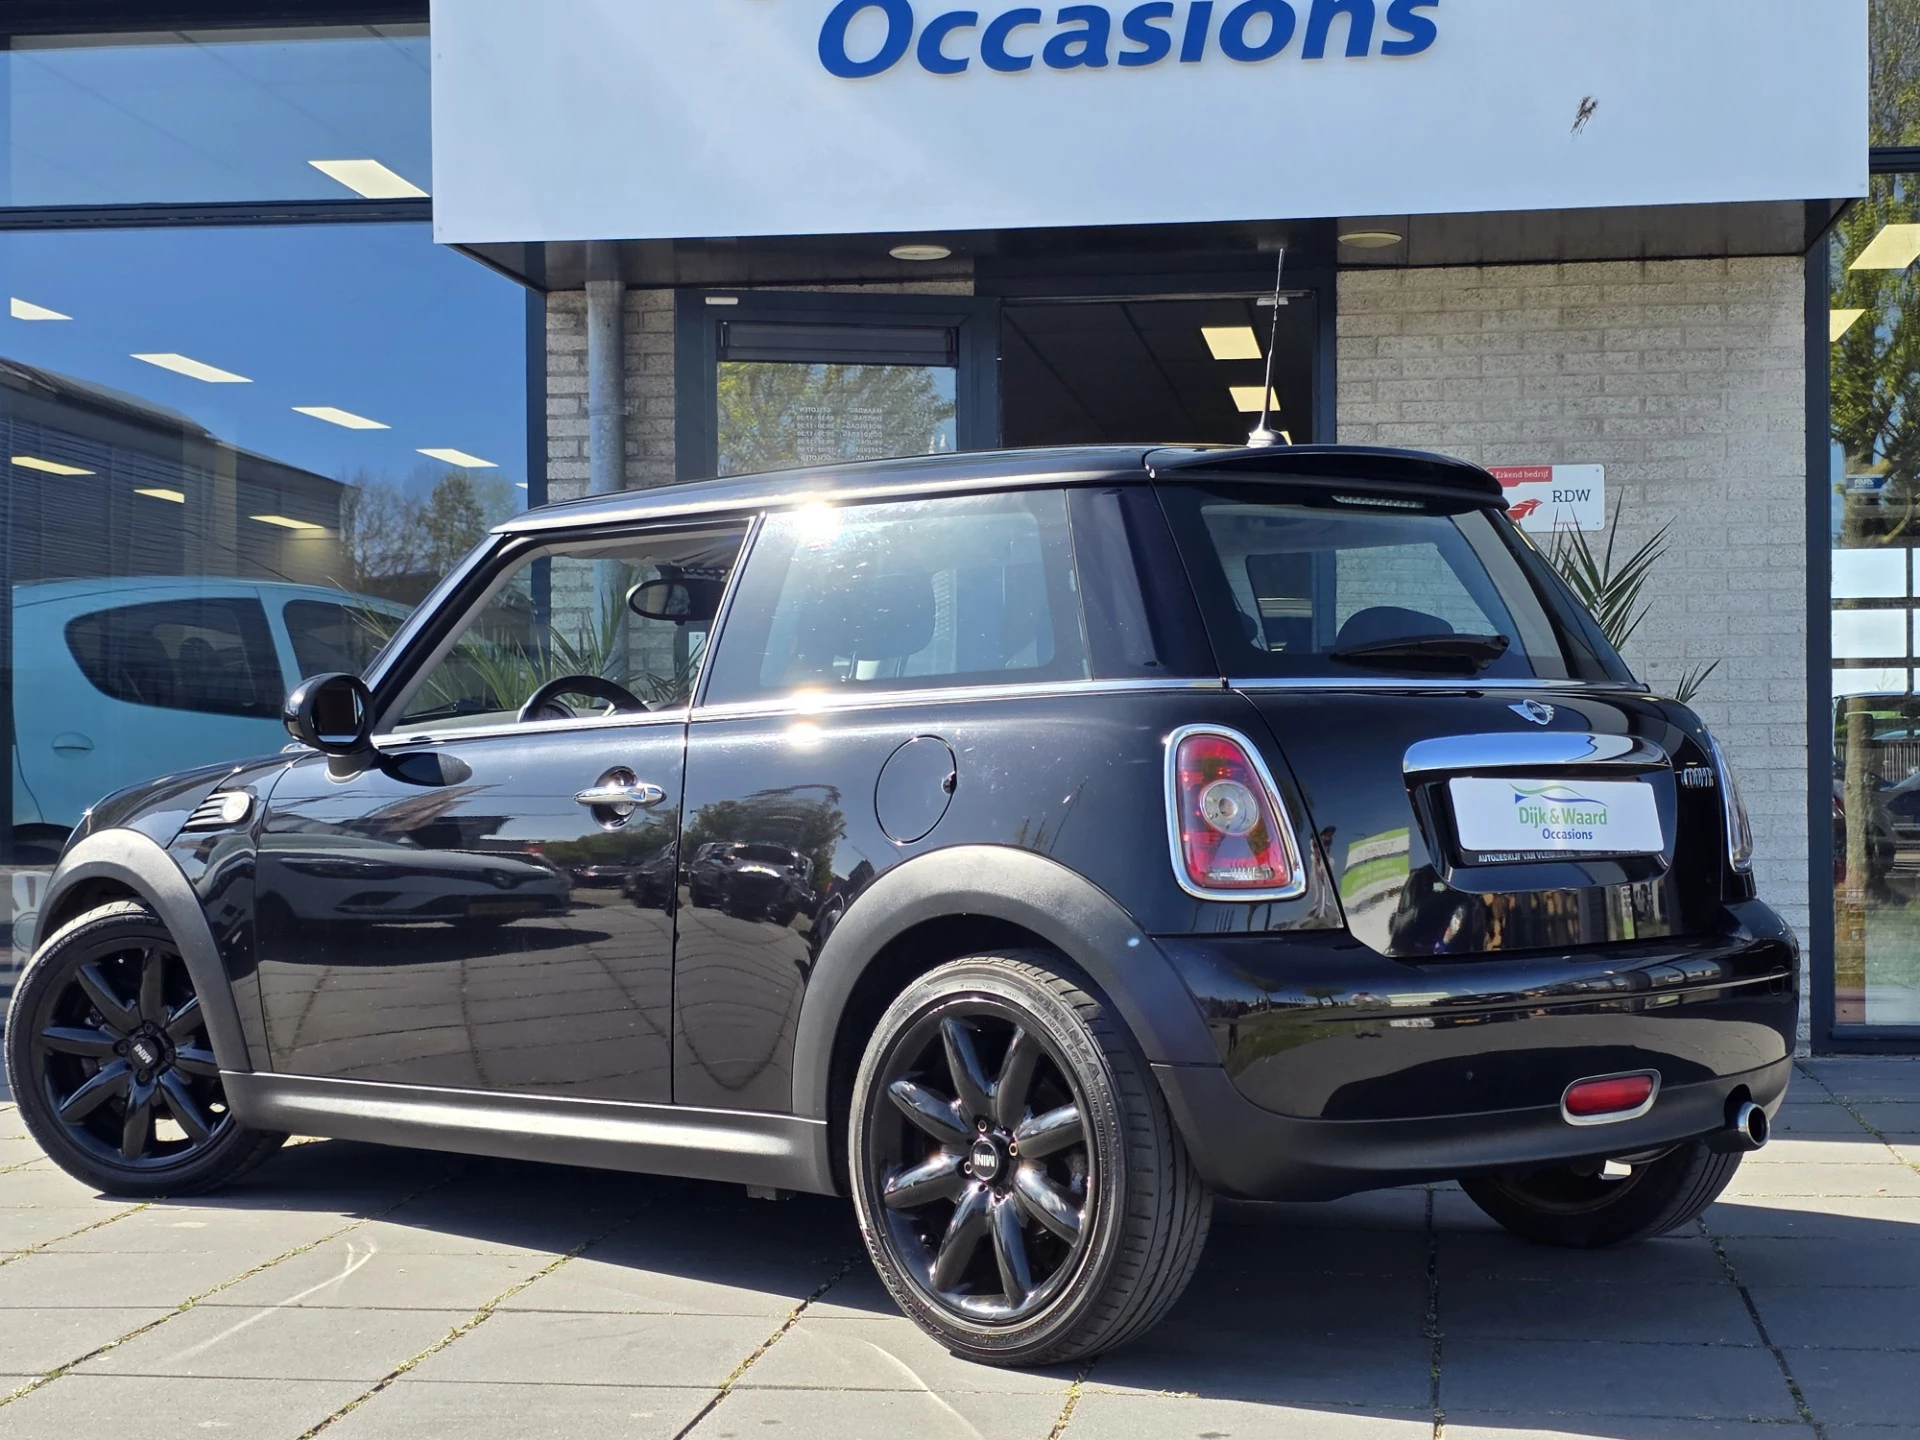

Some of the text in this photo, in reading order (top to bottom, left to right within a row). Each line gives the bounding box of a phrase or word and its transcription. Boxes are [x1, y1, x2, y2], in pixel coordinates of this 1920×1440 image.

[818, 0, 1438, 78] Occasions
[1495, 470, 1549, 479] Erkend bedrijf
[1552, 489, 1591, 503] RDW
[1518, 807, 1608, 828] Dijk & Waard
[1542, 828, 1593, 840] Occasions
[133, 1043, 153, 1064] MINI
[974, 1153, 996, 1167] MINI
